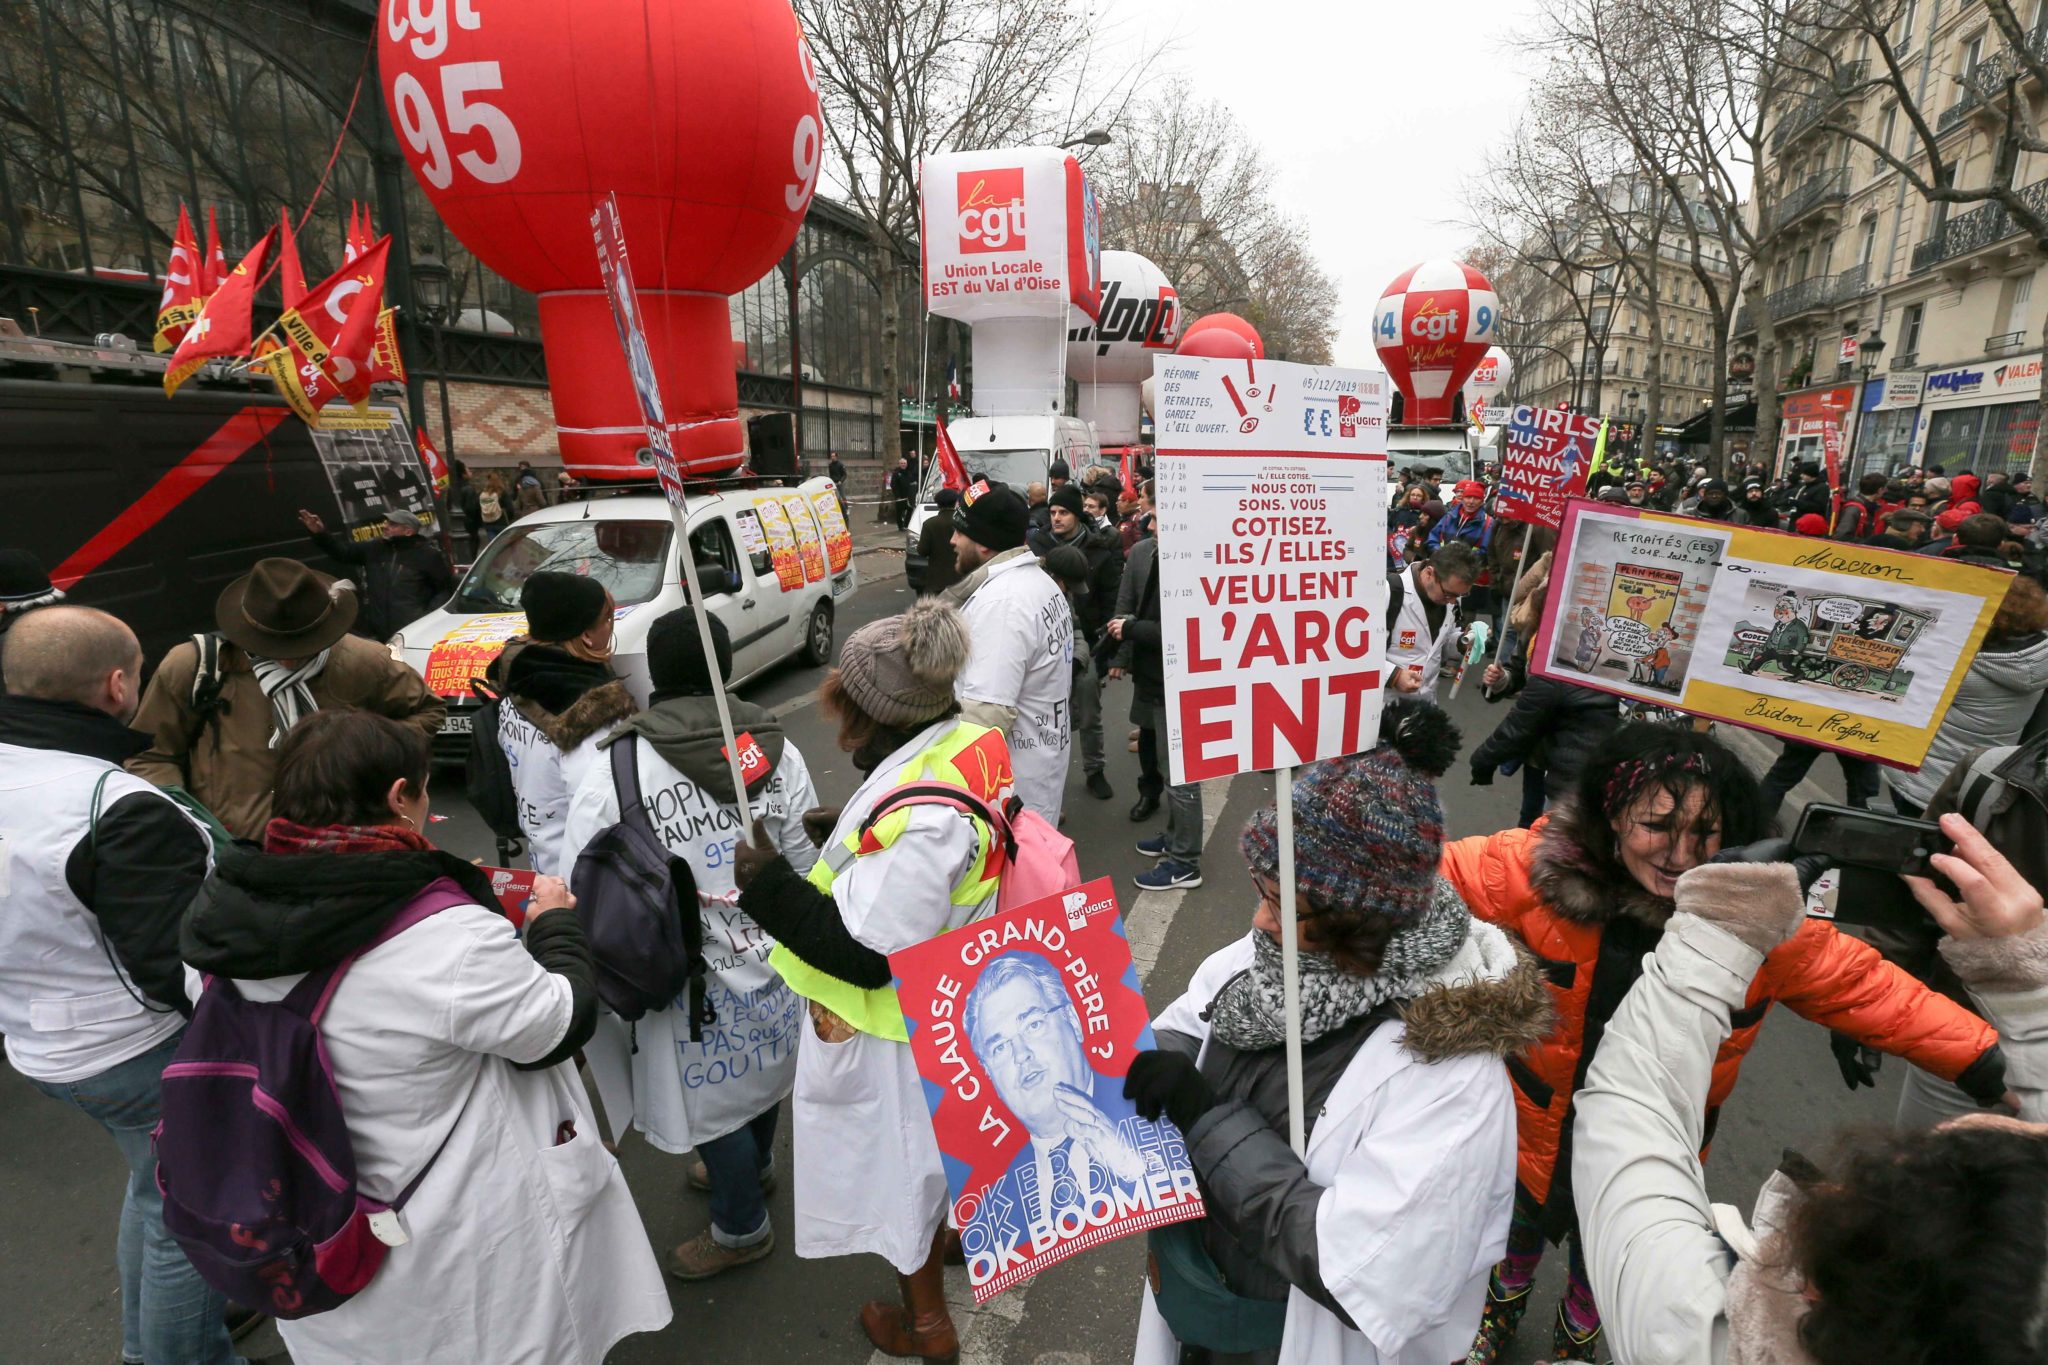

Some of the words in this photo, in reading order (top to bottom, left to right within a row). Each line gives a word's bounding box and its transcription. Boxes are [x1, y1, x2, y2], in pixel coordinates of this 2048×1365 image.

[394, 61, 521, 189] 95
[959, 197, 1027, 247] cgt
[945, 263, 987, 279] Union
[992, 260, 1043, 276] Locale
[933, 282, 959, 297] EST
[964, 280, 981, 295] du
[985, 278, 1009, 293] Val
[1014, 276, 1061, 293] d'Oise
[287, 316, 315, 352] Ville
[1410, 309, 1458, 341] cgt
[1164, 366, 1200, 380] RÉFORME
[1302, 378, 1357, 392] 05/12/2019
[1475, 365, 1499, 382] cgt
[1164, 383, 1180, 392] DES
[1164, 397, 1213, 409] RETRAITES,
[1165, 410, 1196, 420] GARDEZ
[1195, 424, 1230, 434] OUVERT.
[1356, 417, 1382, 426] UGICT
[1513, 404, 1600, 439] GIRLS
[1508, 429, 1558, 452] JUST
[1506, 447, 1581, 476] WANNA
[1251, 484, 1287, 494] NOUS
[1290, 484, 1316, 494] COTI
[1500, 465, 1553, 489] HAVE
[1239, 499, 1285, 511] SONS.
[1290, 499, 1326, 511] VOUS
[1232, 516, 1333, 537] COTISEZ.
[1216, 541, 1254, 564] ILS
[1280, 540, 1346, 562] ELLES
[1793, 547, 1914, 581] Macron
[1621, 566, 1646, 576] PLAN
[1648, 569, 1680, 581] MACRON
[1200, 570, 1358, 606] VEULENT
[1186, 606, 1370, 674] L'ARG
[1400, 635, 1416, 645] cgt
[1743, 632, 1767, 642] RODEZ
[431, 667, 454, 679] TOUS
[455, 666, 468, 677] EN
[1035, 713, 1049, 728] DU
[1179, 670, 1381, 784] ENT
[765, 777, 783, 795] DE
[705, 838, 736, 869] 95
[1067, 907, 1084, 920] cgt
[1085, 899, 1114, 914] UGICT
[961, 918, 1110, 1035] GRAND-PÈRE
[700, 1024, 745, 1057] PAS
[748, 1023, 782, 1042] QUE
[931, 974, 981, 1101] CLAUSE
[1091, 1041, 1114, 1060] ?
[978, 1103, 1011, 1147] LA
[954, 1175, 1014, 1229] OK
[960, 1202, 1020, 1257] OK
[967, 1230, 1029, 1286] OK
[1029, 1169, 1202, 1256] BOOMER
